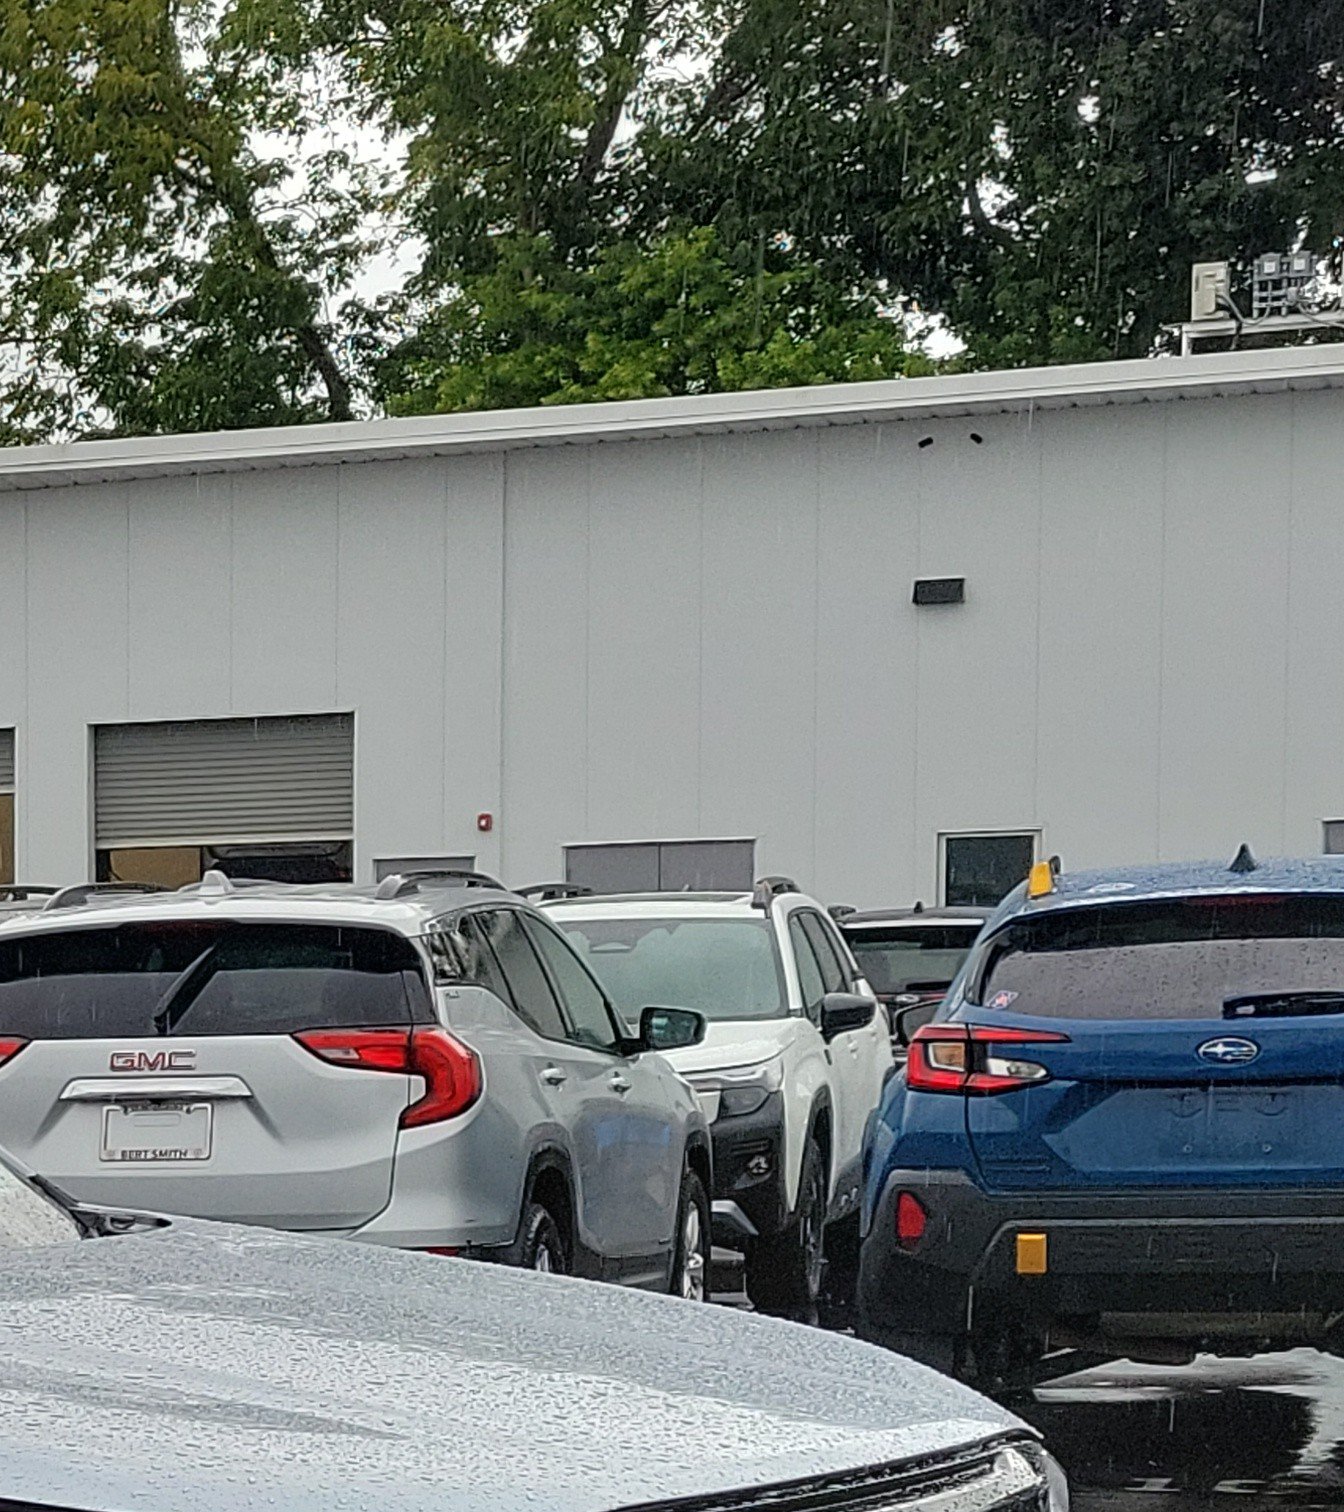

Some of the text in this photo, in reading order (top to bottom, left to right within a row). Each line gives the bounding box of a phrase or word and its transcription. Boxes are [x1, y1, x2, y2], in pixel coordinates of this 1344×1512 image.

[110, 1051, 196, 1072] GMC
[121, 1149, 189, 1160] BERT SMITH
